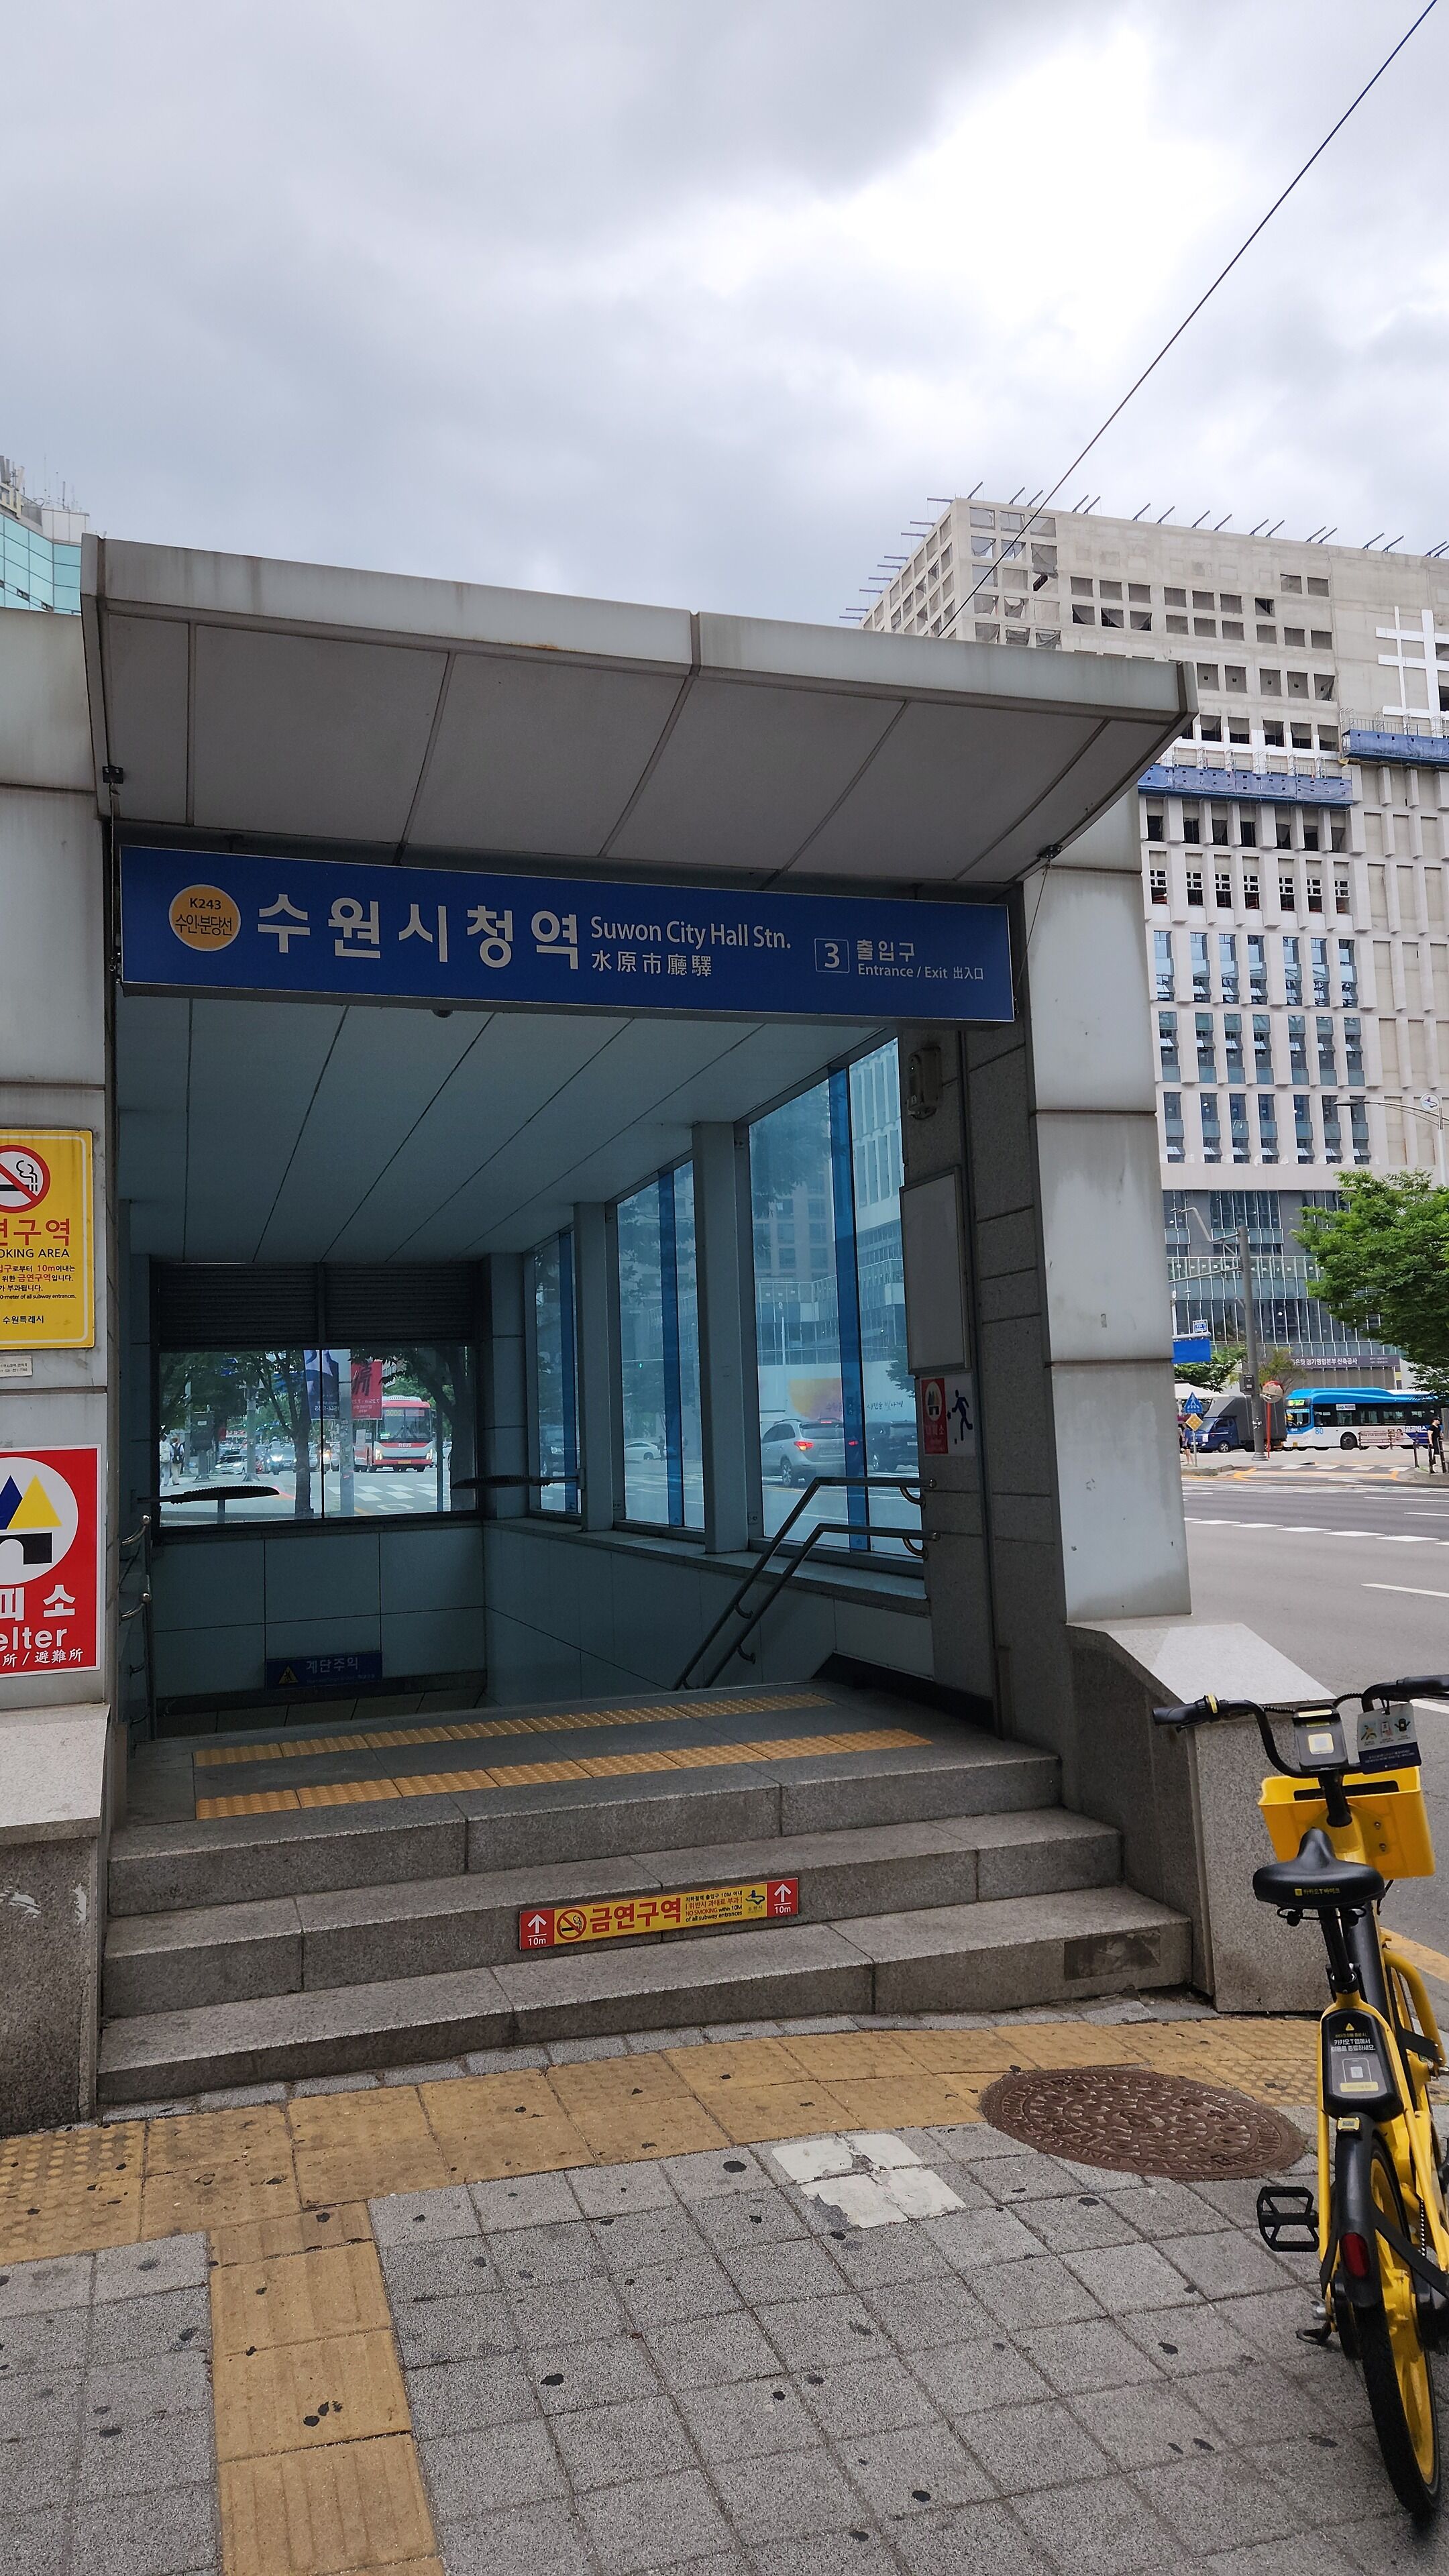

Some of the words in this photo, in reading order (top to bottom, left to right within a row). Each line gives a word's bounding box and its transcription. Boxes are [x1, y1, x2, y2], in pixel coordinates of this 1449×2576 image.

[189, 898, 221, 910] K243
[257, 894, 579, 969] 수원시청역
[590, 916, 661, 943] Suwon
[666, 920, 706, 950] City
[711, 923, 749, 947] Hall
[753, 926, 792, 949] Stn.
[824, 943, 840, 968] 3
[856, 939, 916, 962] 출입구
[592, 950, 712, 977] 水原市廳驛
[857, 963, 914, 978] Entrance
[924, 965, 948, 979] Exit
[953, 967, 984, 981] 出入口
[38, 1248, 70, 1258] AREA
[37, 1265, 76, 1273] 10m이내는
[17, 1273, 74, 1282] 금연구역입니다.
[3, 1316, 44, 1324] 수원특례시
[1337, 1357, 1358, 1365] 신축공사
[34, 1648, 84, 1664] 避難所
[306, 1657, 358, 1674] 계단주의
[689, 1900, 706, 1909] 위반시
[708, 1898, 725, 1907] 과태료
[775, 1904, 792, 1914] 10m
[590, 1896, 682, 1934] 금연구역
[694, 1907, 718, 1915] SMOKING
[528, 1936, 547, 1946] 10m
